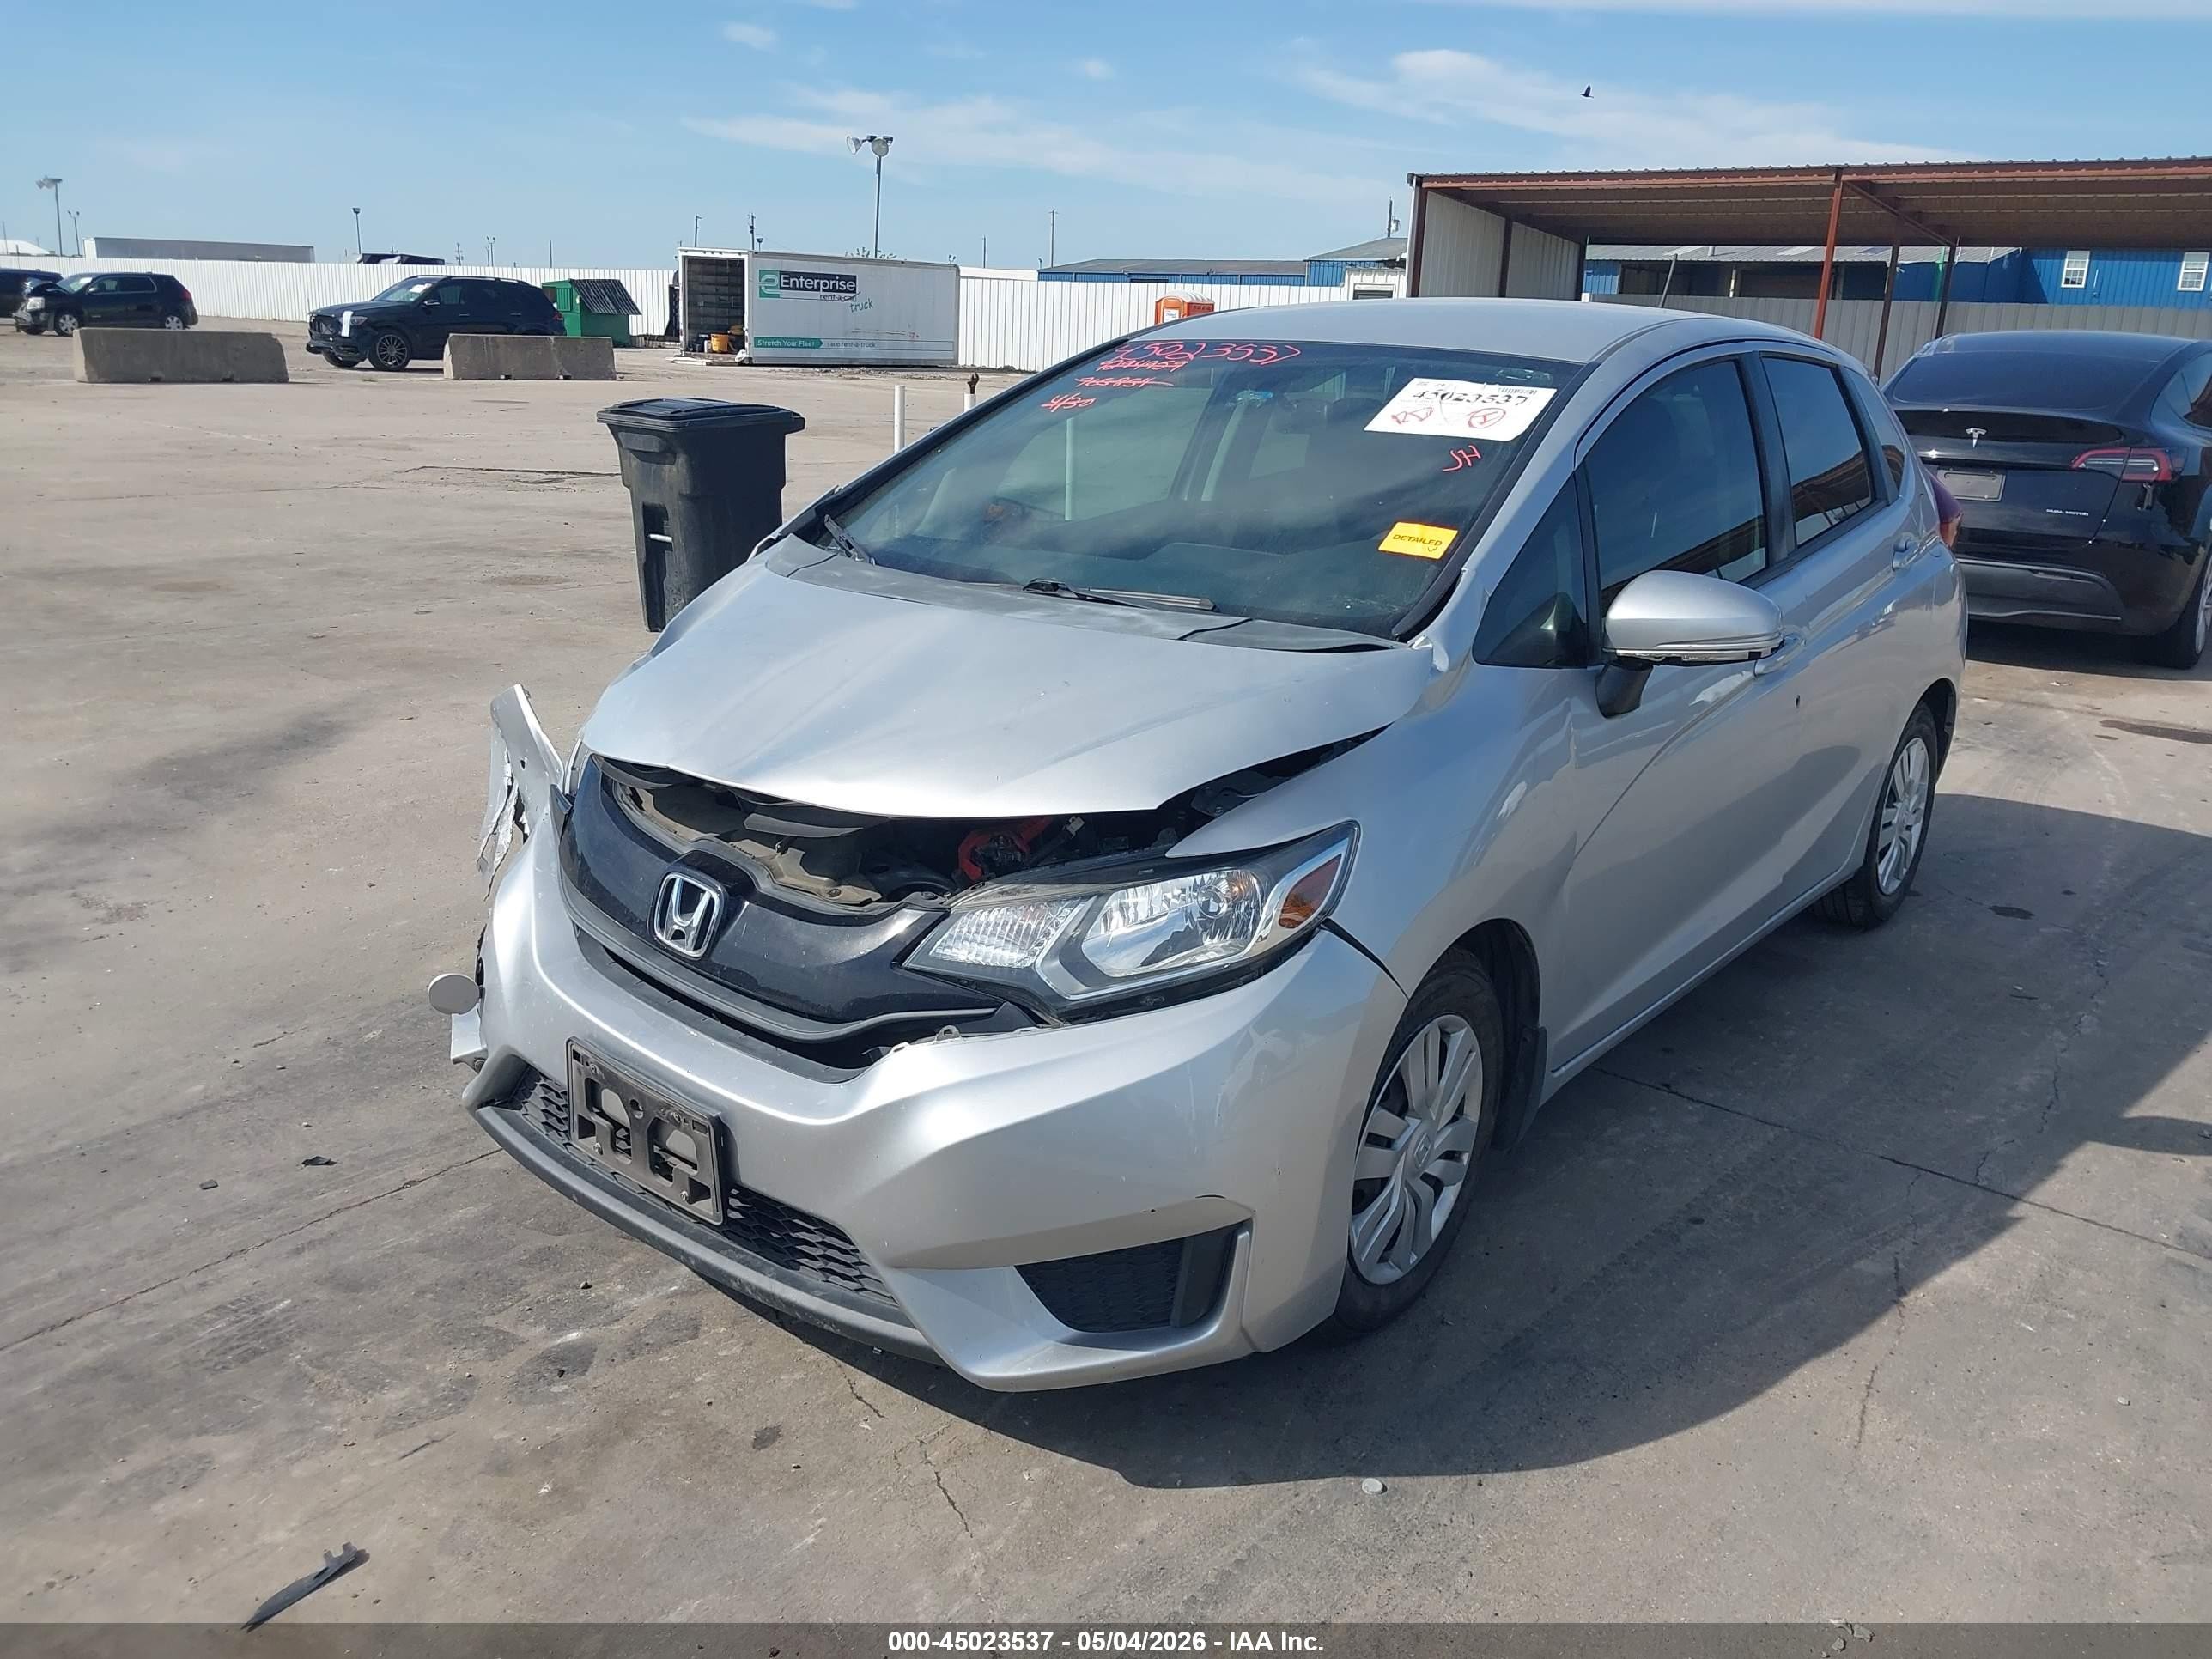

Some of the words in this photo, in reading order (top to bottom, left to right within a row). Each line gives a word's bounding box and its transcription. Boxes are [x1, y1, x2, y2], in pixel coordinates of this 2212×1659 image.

[780, 274, 857, 293] Enterprise
[849, 298, 874, 313] truck
[1392, 534, 1443, 546] DETAILED
